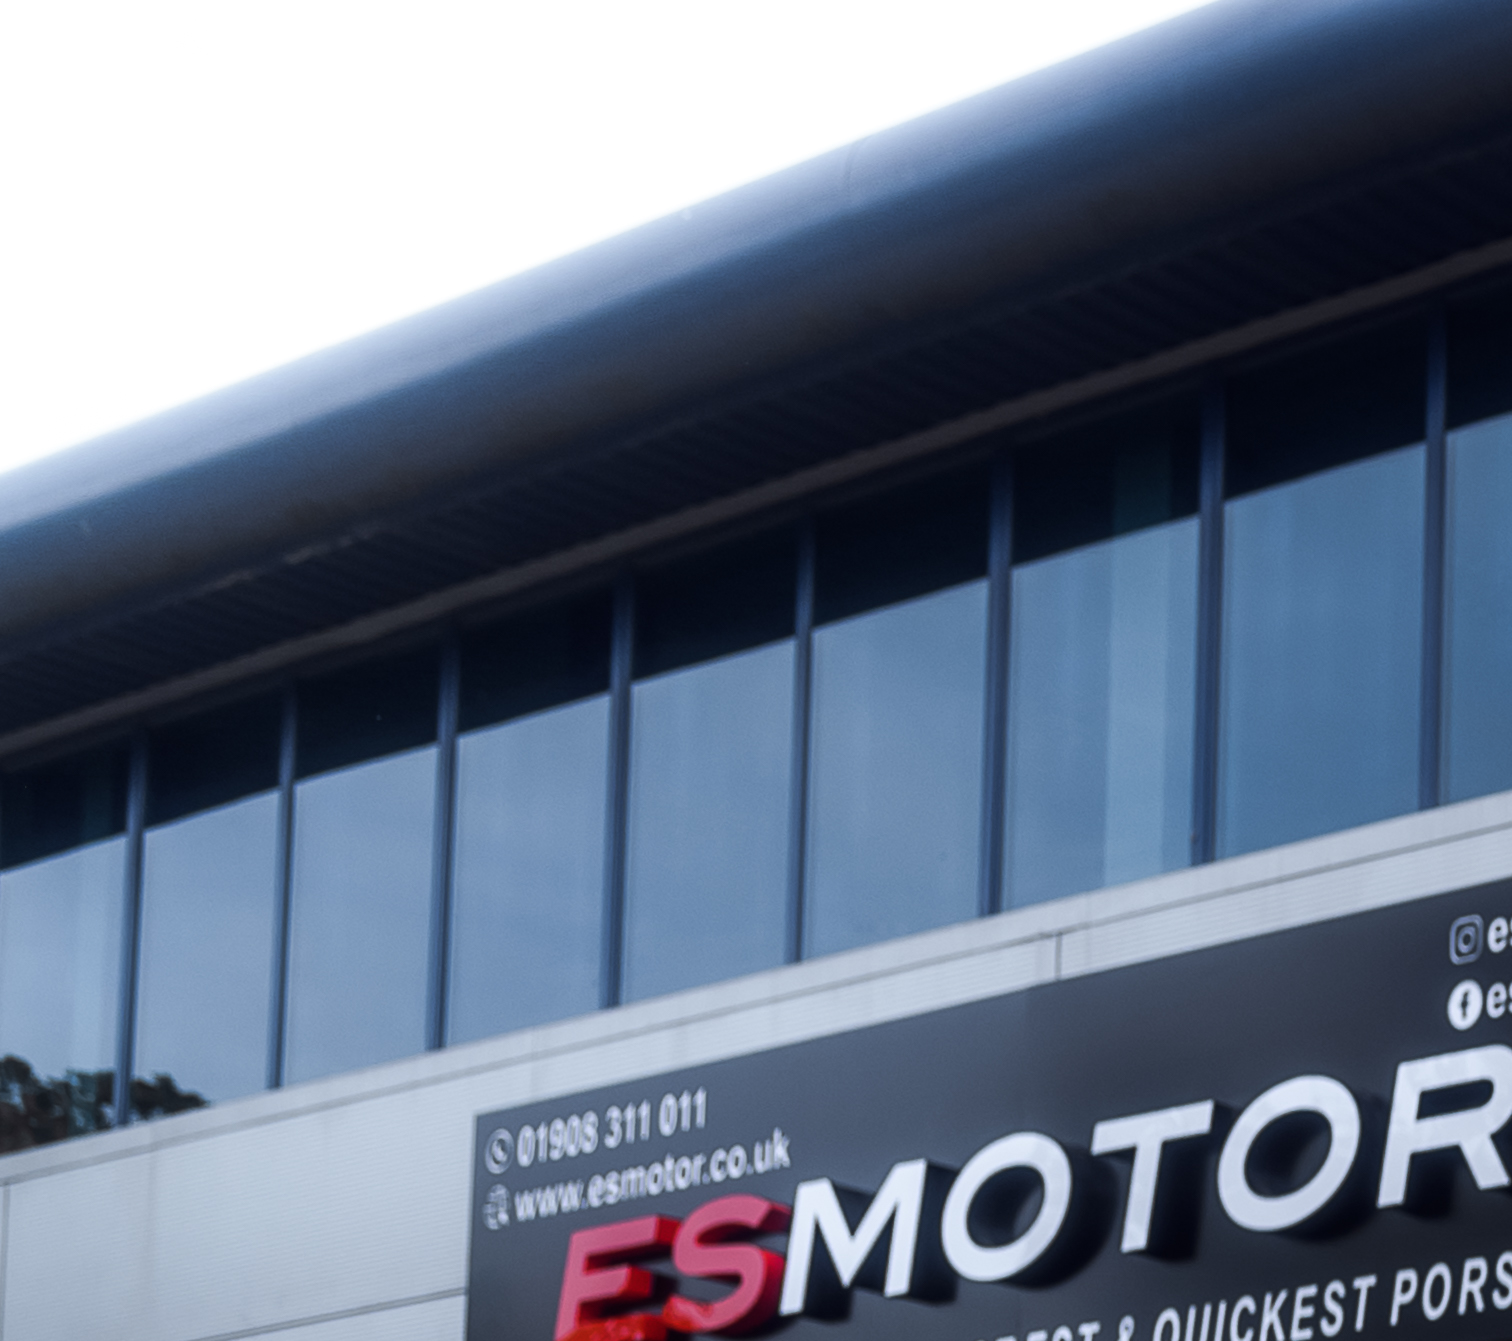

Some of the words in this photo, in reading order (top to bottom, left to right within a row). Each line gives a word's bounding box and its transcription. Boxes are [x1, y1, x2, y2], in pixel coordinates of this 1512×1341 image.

[517, 1112, 598, 1166] 01908
[605, 1101, 650, 1148] 311
[659, 1089, 706, 1136] 011
[515, 1129, 790, 1220] www.esmotor.co.uk
